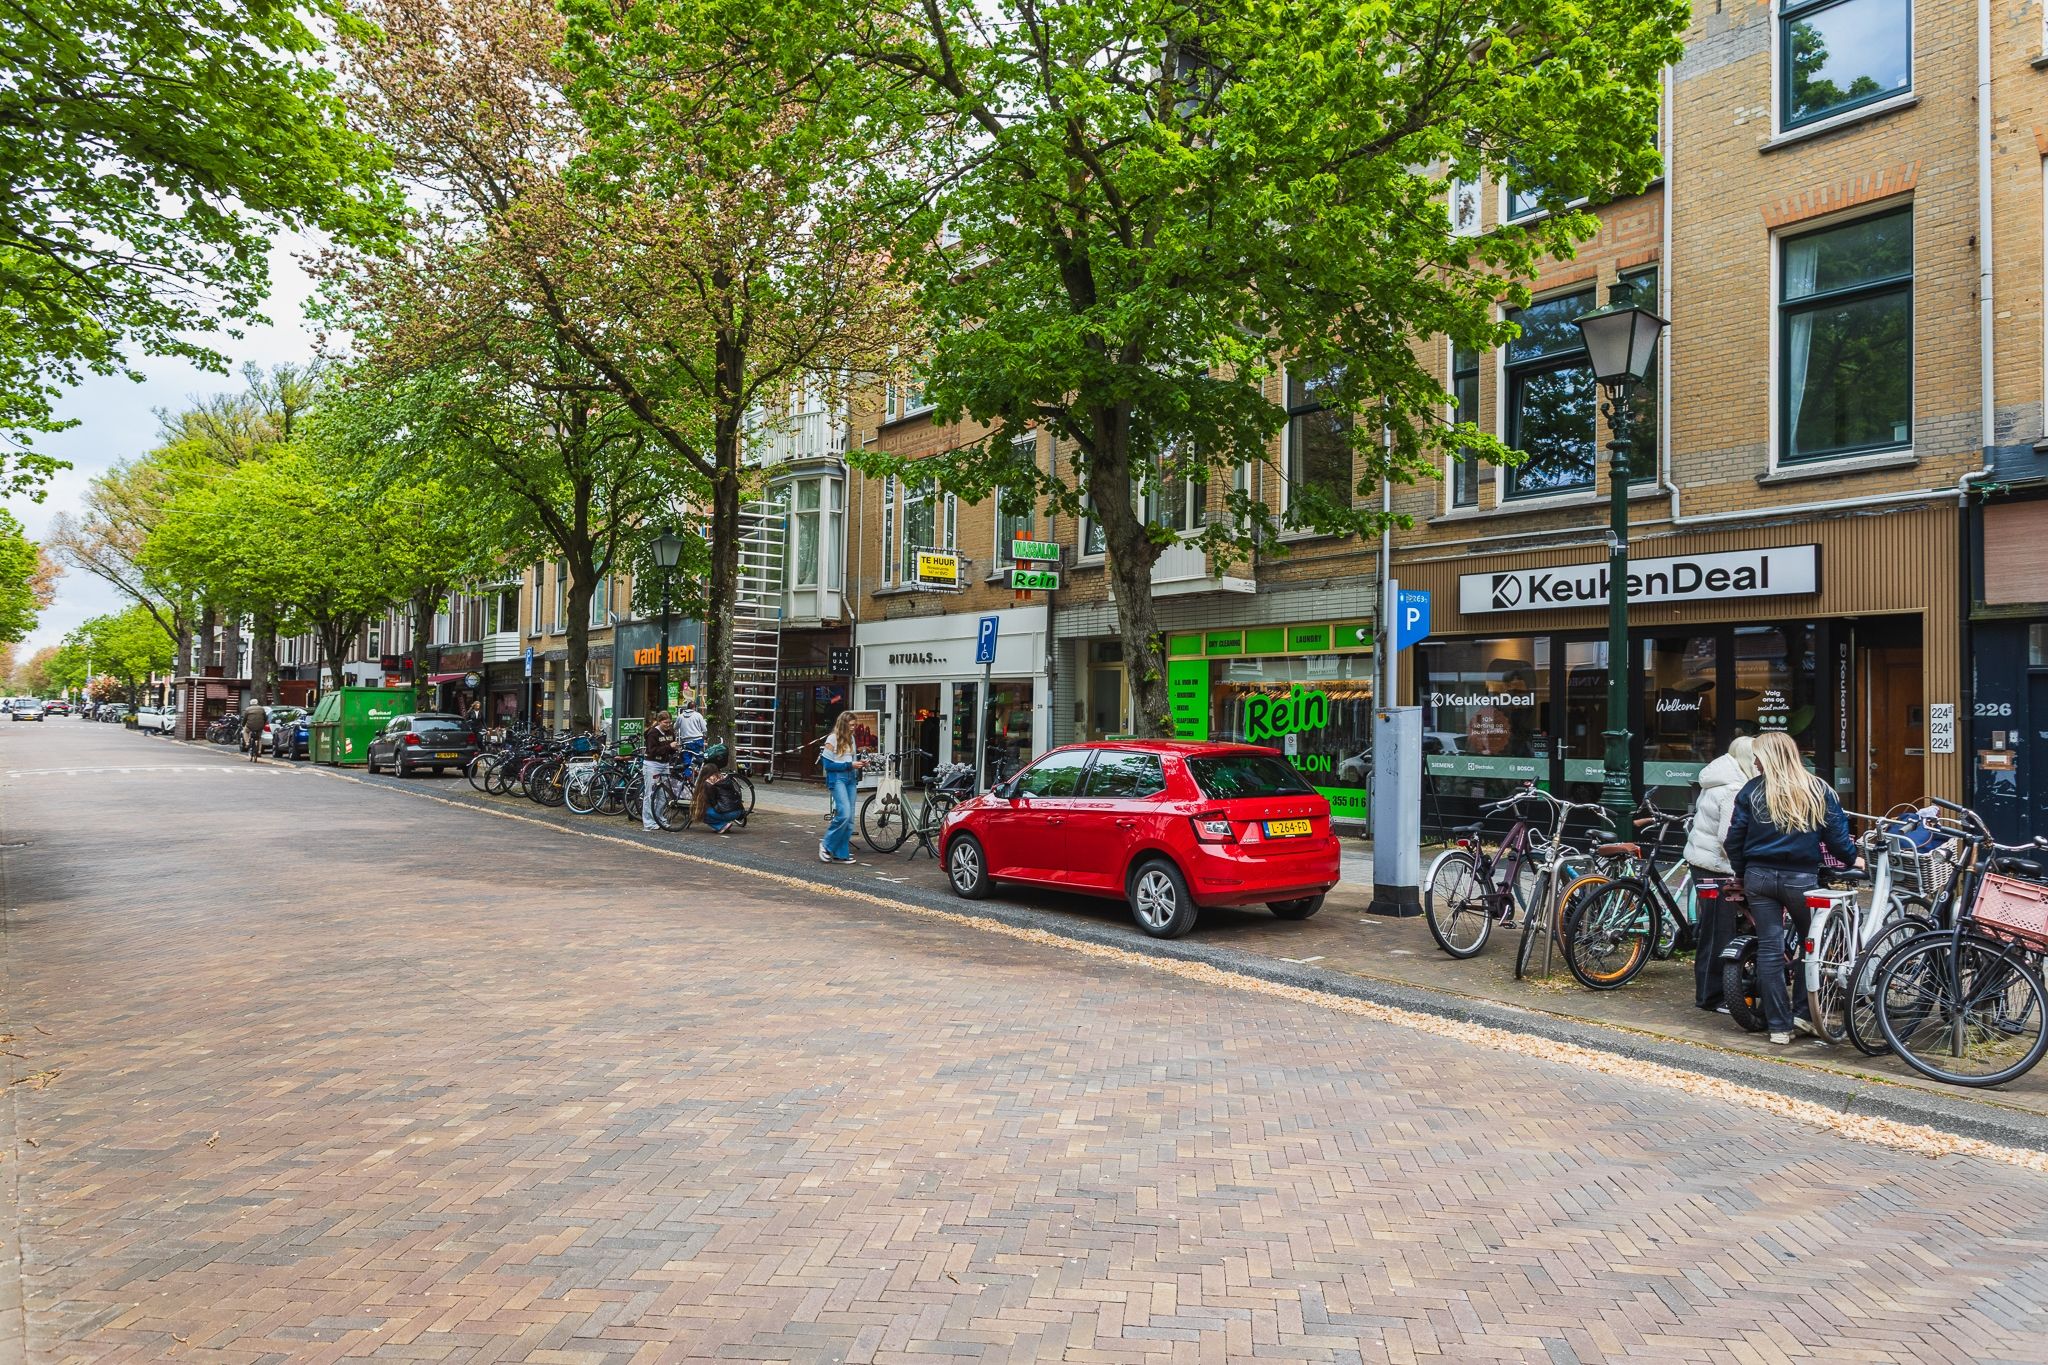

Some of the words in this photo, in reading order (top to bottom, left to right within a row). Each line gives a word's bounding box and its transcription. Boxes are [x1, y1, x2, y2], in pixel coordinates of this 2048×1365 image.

[1014, 541, 1058, 559] WASSALON
[934, 558, 955, 566] HUUR
[1014, 572, 1055, 587] Rein
[1407, 608, 1420, 631] P
[982, 620, 993, 643] P
[1296, 635, 1321, 643] LAUNDRY
[1445, 692, 1535, 706] KeukenDeal
[1656, 697, 1702, 712] Welkom!
[1247, 687, 1325, 739] Rein
[1974, 703, 2012, 716] 226
[621, 722, 642, 731] -20%
[1665, 770, 1694, 778] Quooker
[1332, 795, 1347, 807] 355
[1349, 796, 1359, 807] 01
[1271, 821, 1308, 834] L-264-FD
